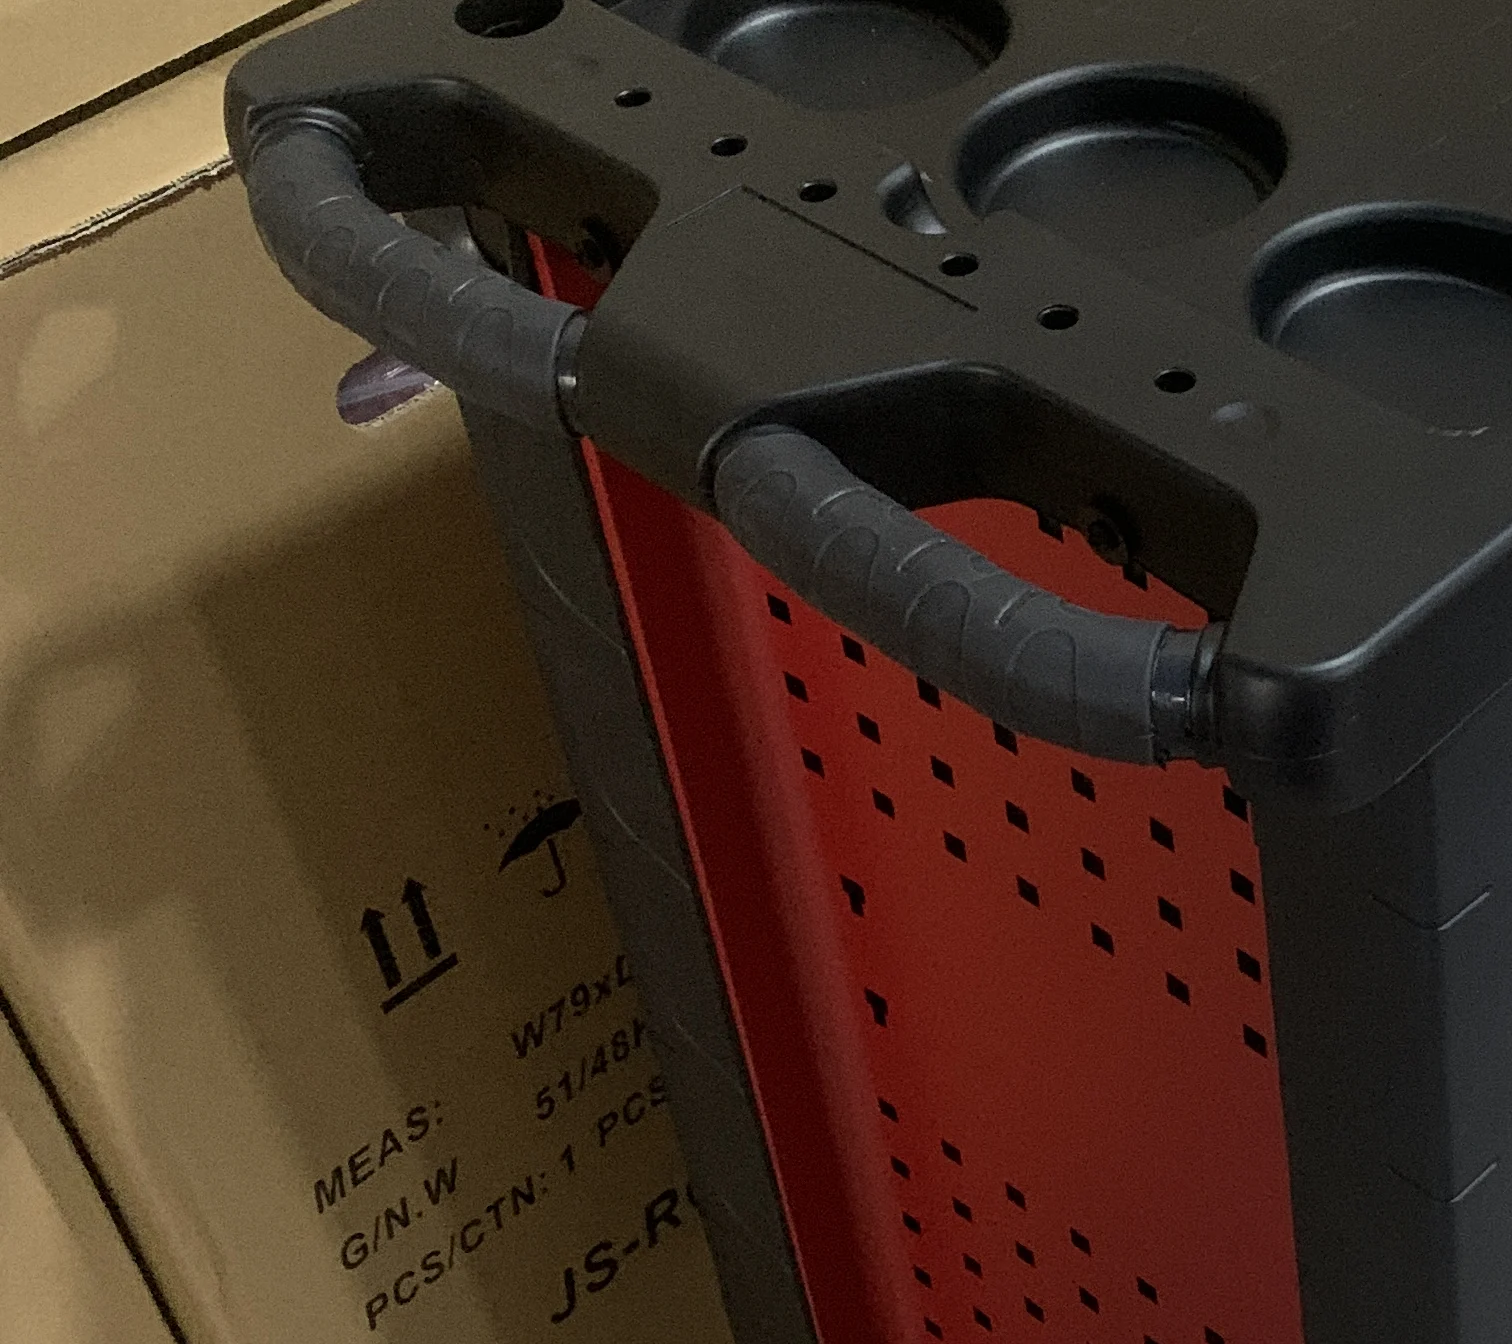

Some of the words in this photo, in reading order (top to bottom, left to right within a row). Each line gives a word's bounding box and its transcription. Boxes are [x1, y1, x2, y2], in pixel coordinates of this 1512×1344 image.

[313, 1100, 443, 1214] MEAS:
[340, 1157, 458, 1271] G/N.W
[364, 1171, 548, 1331] PCS/CTN:
[559, 1143, 576, 1175] 1
[595, 1075, 669, 1148] PCS
[550, 1183, 705, 1325] JS-R
